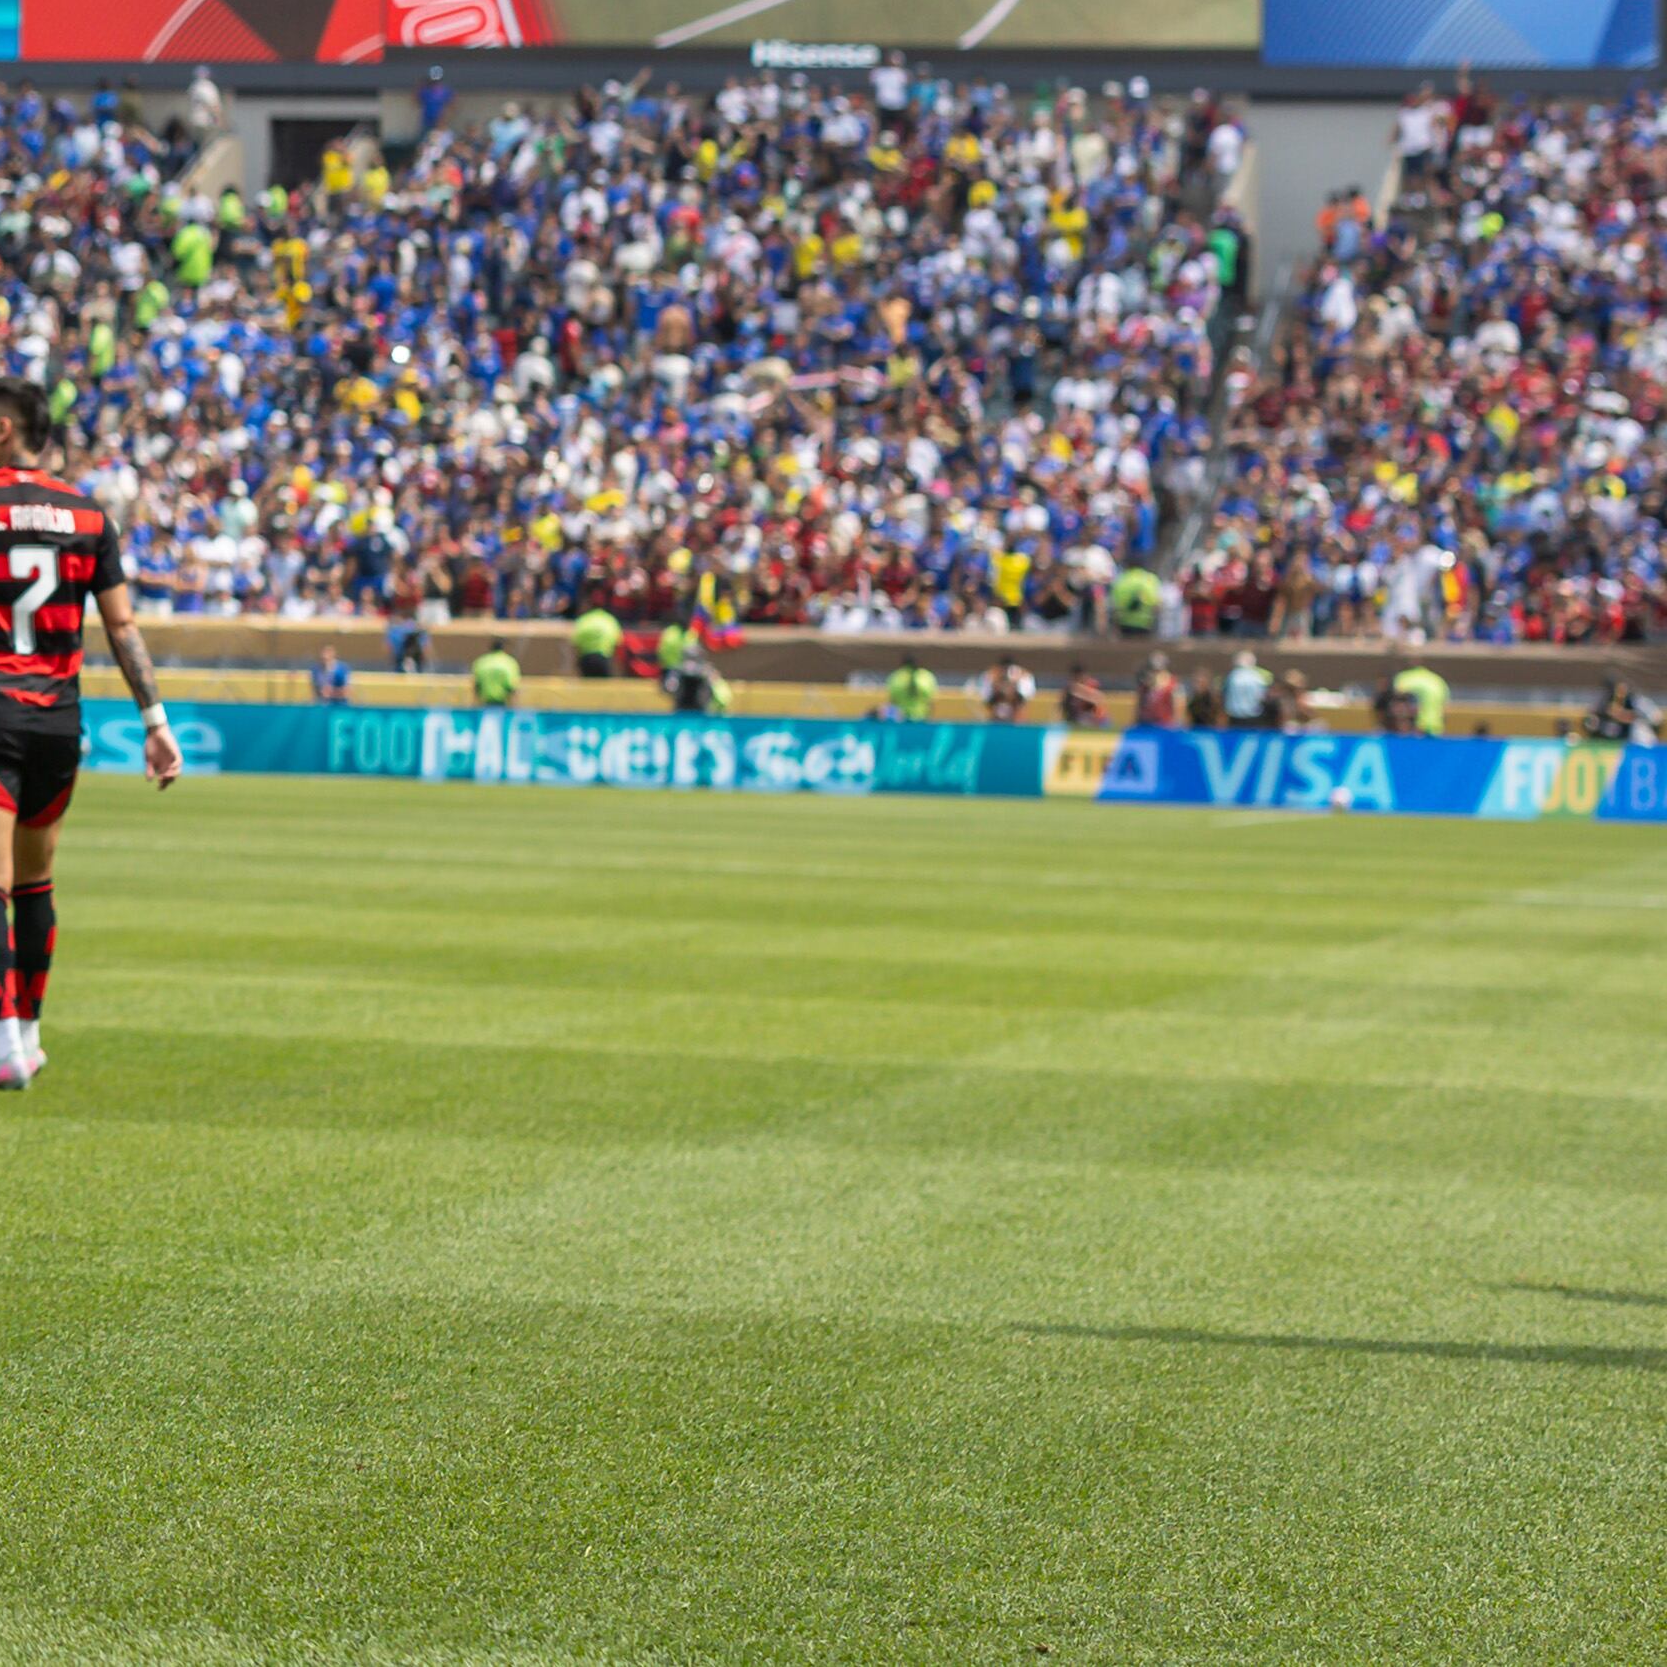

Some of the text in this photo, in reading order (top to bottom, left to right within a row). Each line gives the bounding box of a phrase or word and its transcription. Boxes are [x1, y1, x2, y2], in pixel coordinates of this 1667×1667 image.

[9, 545, 59, 655] 7
[1187, 732, 1395, 809] VISA
[1503, 744, 1667, 814] FOOTB
